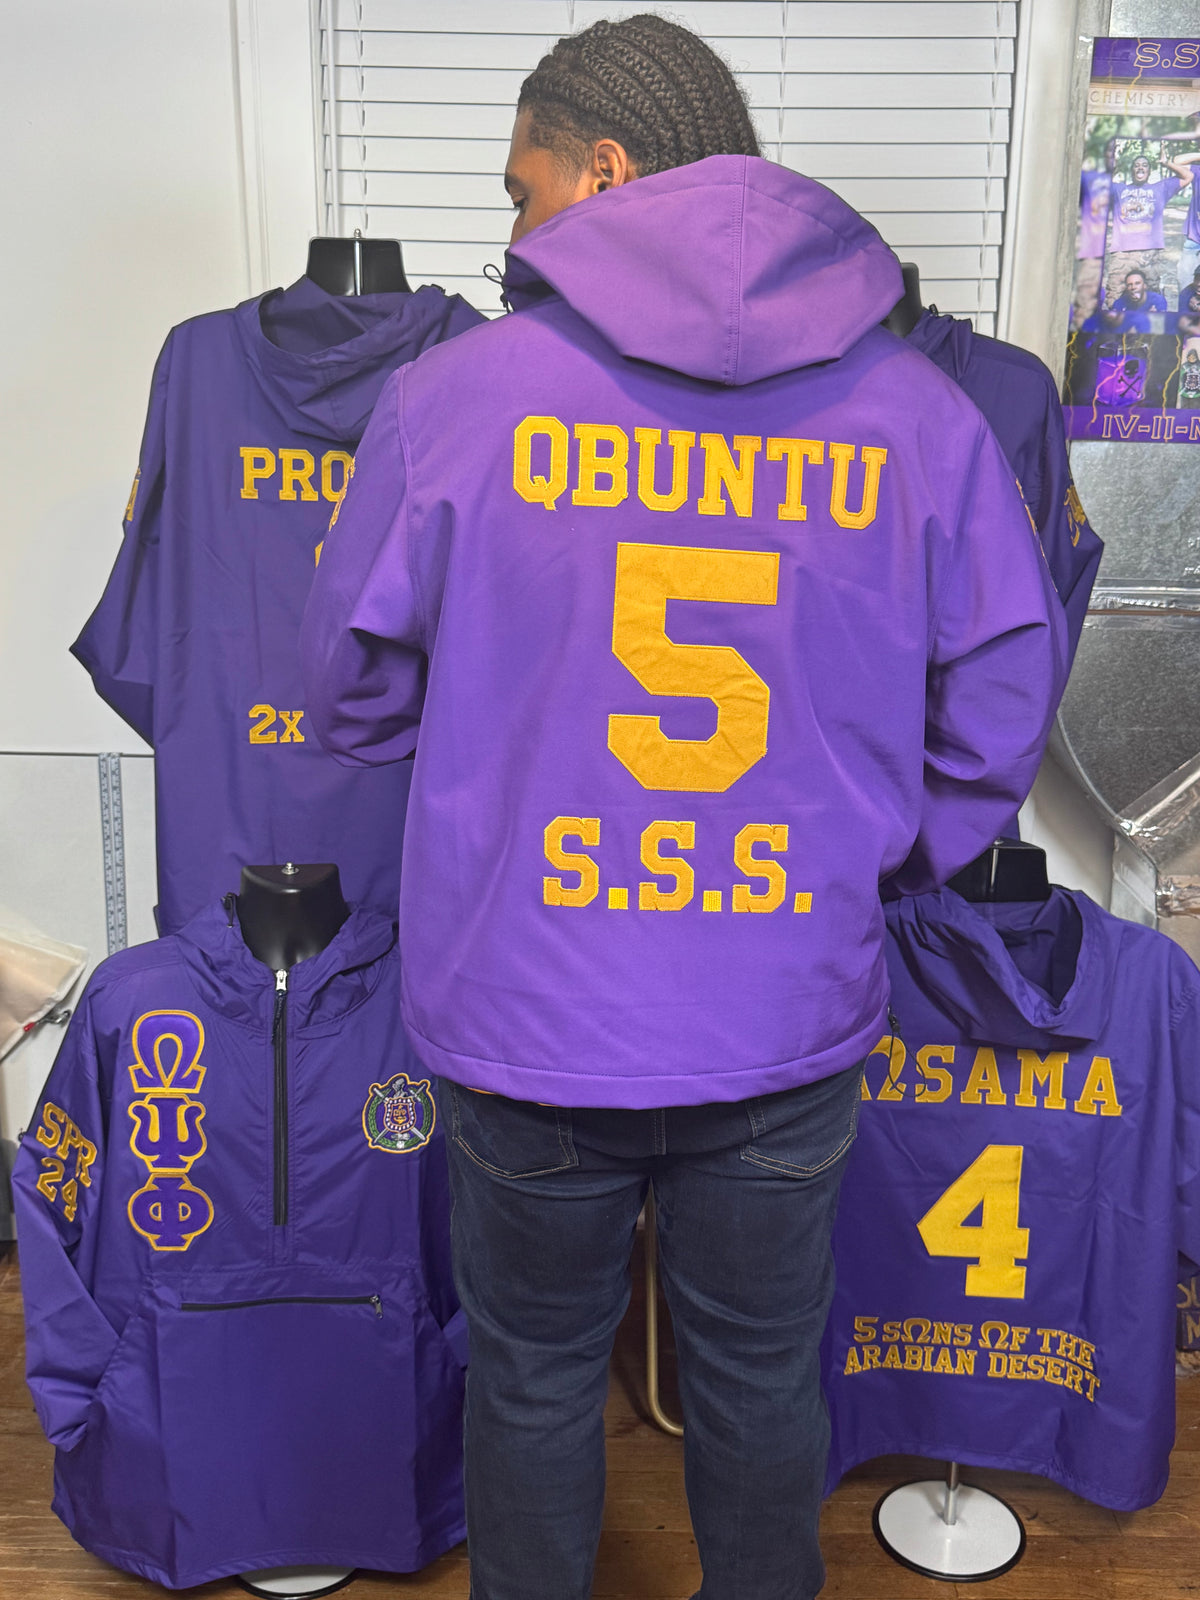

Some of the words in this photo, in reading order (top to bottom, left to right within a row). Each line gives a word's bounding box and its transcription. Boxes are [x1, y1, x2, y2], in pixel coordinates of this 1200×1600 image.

[1089, 90, 1188, 106] CHEMISTRY
[513, 416, 888, 530] QBUNTU
[608, 542, 780, 793] 5
[543, 816, 813, 913] S.S.S.
[36, 1102, 97, 1188] SPR
[36, 1157, 78, 1222] 24
[917, 1144, 1030, 1299] 4
[844, 1345, 977, 1375] ARABIAN
[987, 1352, 1100, 1403] DESERT
[854, 1316, 879, 1343] 5
[1037, 1328, 1096, 1370] THE
